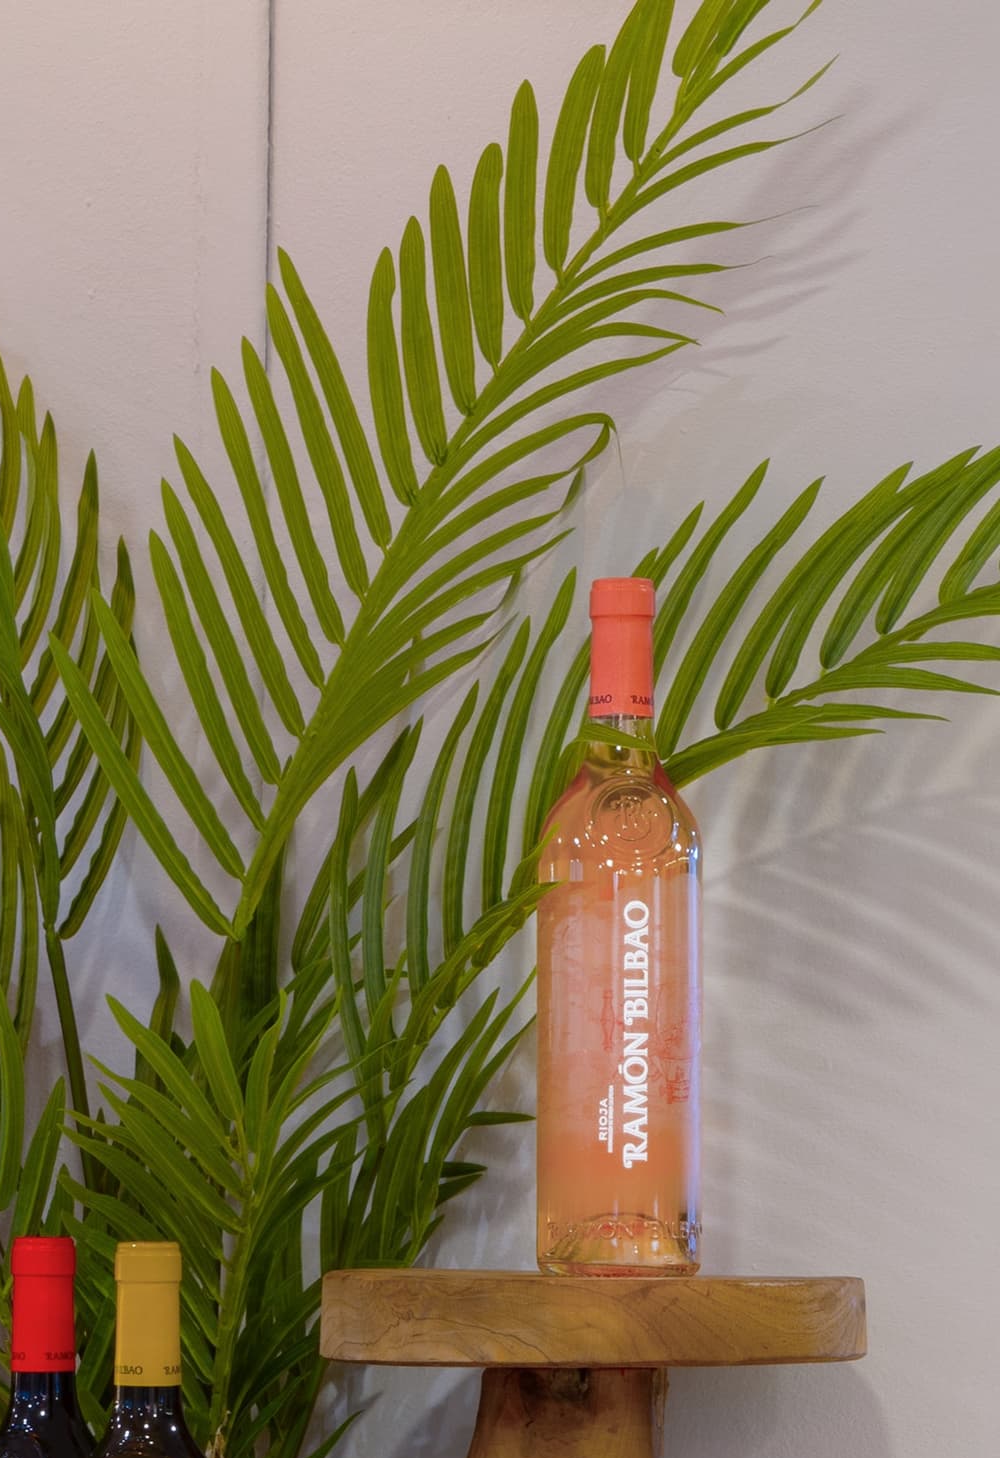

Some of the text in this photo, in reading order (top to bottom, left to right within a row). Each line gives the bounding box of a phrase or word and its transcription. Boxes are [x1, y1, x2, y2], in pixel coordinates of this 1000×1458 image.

[618, 900, 650, 1169] RAMÓN BILBAO
[599, 1098, 608, 1141] RIOJA
